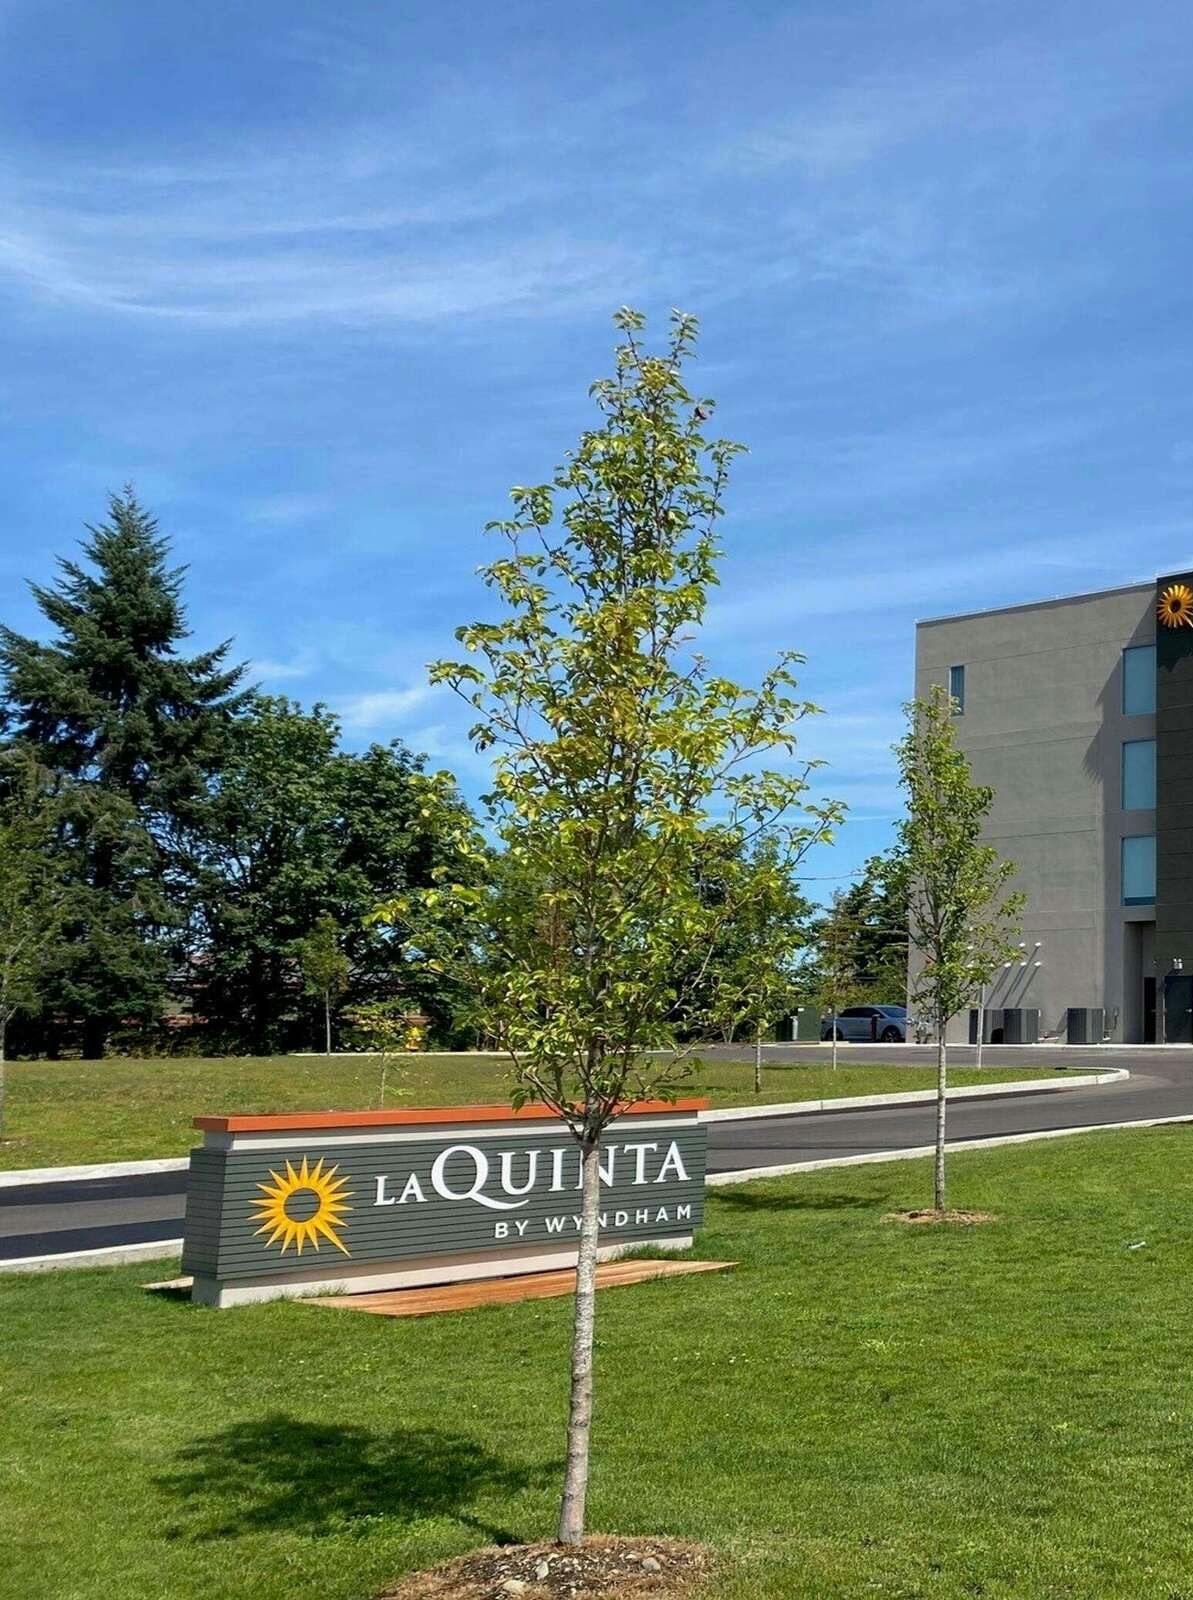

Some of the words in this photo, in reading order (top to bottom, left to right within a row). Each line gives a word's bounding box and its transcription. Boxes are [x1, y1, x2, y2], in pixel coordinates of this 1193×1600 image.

[373, 1172, 428, 1207] LA
[430, 1141, 692, 1210] QUINTA
[494, 1220, 529, 1239] BY
